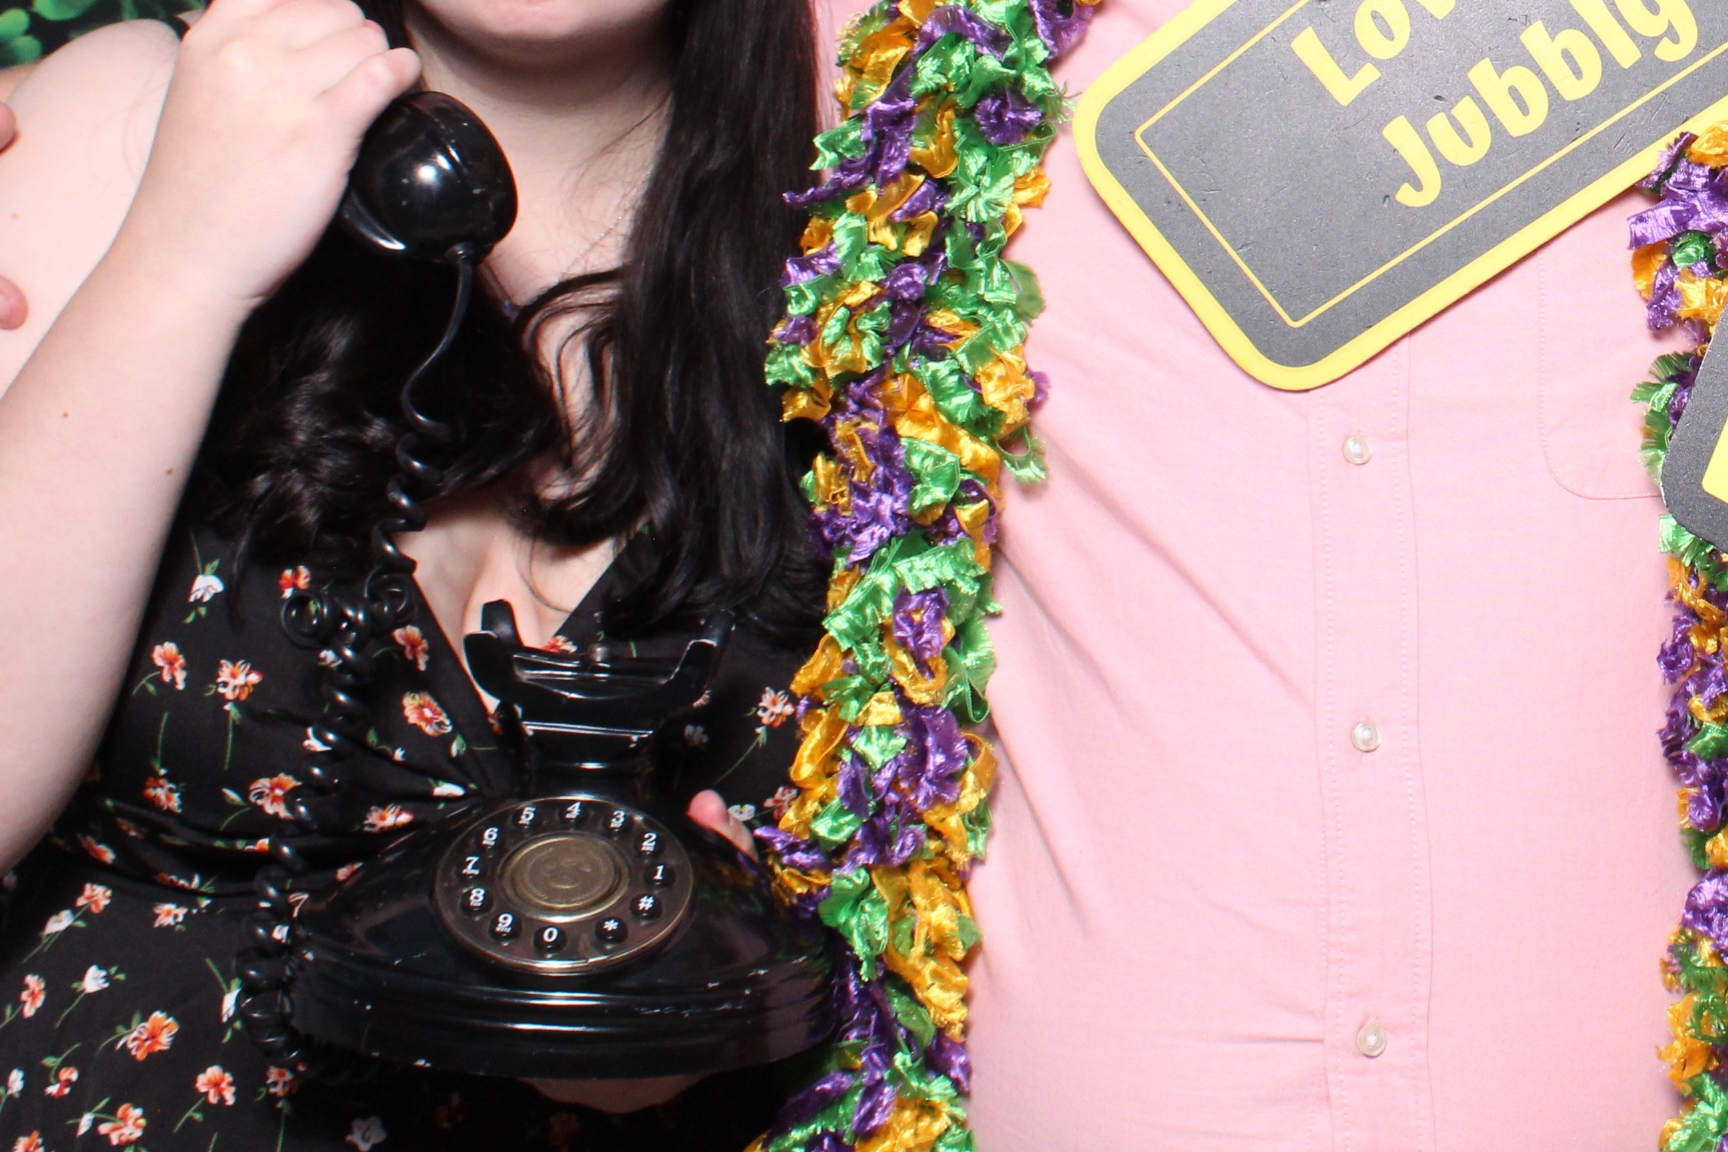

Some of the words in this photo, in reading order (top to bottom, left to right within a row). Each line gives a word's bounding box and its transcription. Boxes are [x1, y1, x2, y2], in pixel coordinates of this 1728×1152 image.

[521, 806, 536, 822] 5
[566, 801, 582, 815] 4
[612, 810, 627, 825] 3
[483, 826, 499, 843] 6
[642, 832, 657, 846] 2
[464, 856, 480, 872] 7
[653, 865, 664, 880] 1
[470, 887, 486, 902] 8
[497, 913, 514, 928] 9
[543, 927, 558, 942] 0
